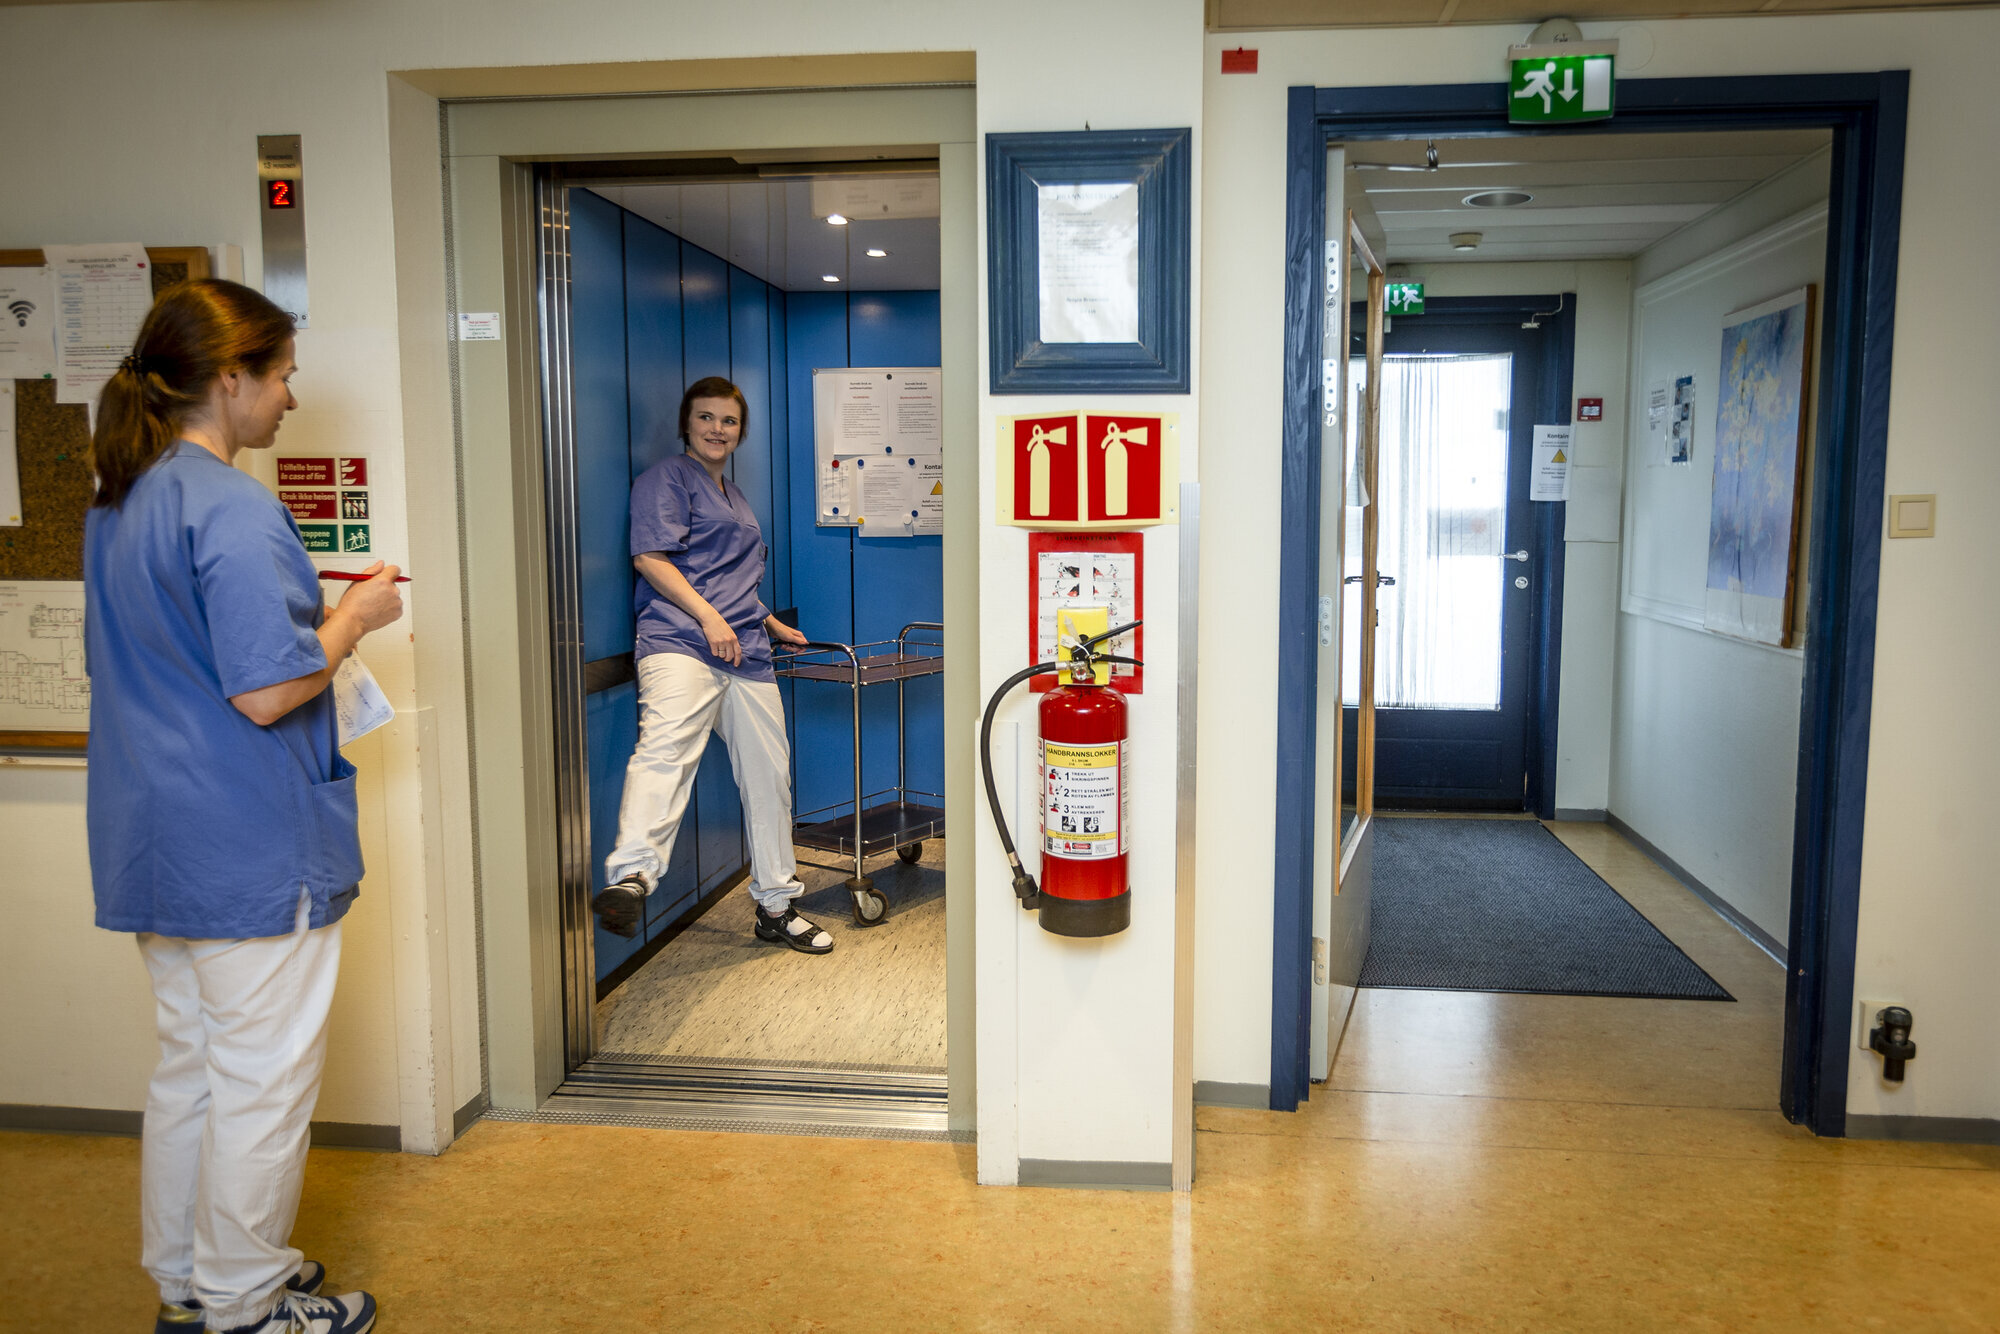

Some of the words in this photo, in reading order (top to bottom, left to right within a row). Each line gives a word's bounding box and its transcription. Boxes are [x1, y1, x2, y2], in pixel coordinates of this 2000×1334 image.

[273, 181, 289, 205] 2
[283, 463, 306, 471] tilfelle
[1065, 772, 1069, 781] 1
[1064, 788, 1070, 797] 2
[1064, 805, 1069, 814] 3
